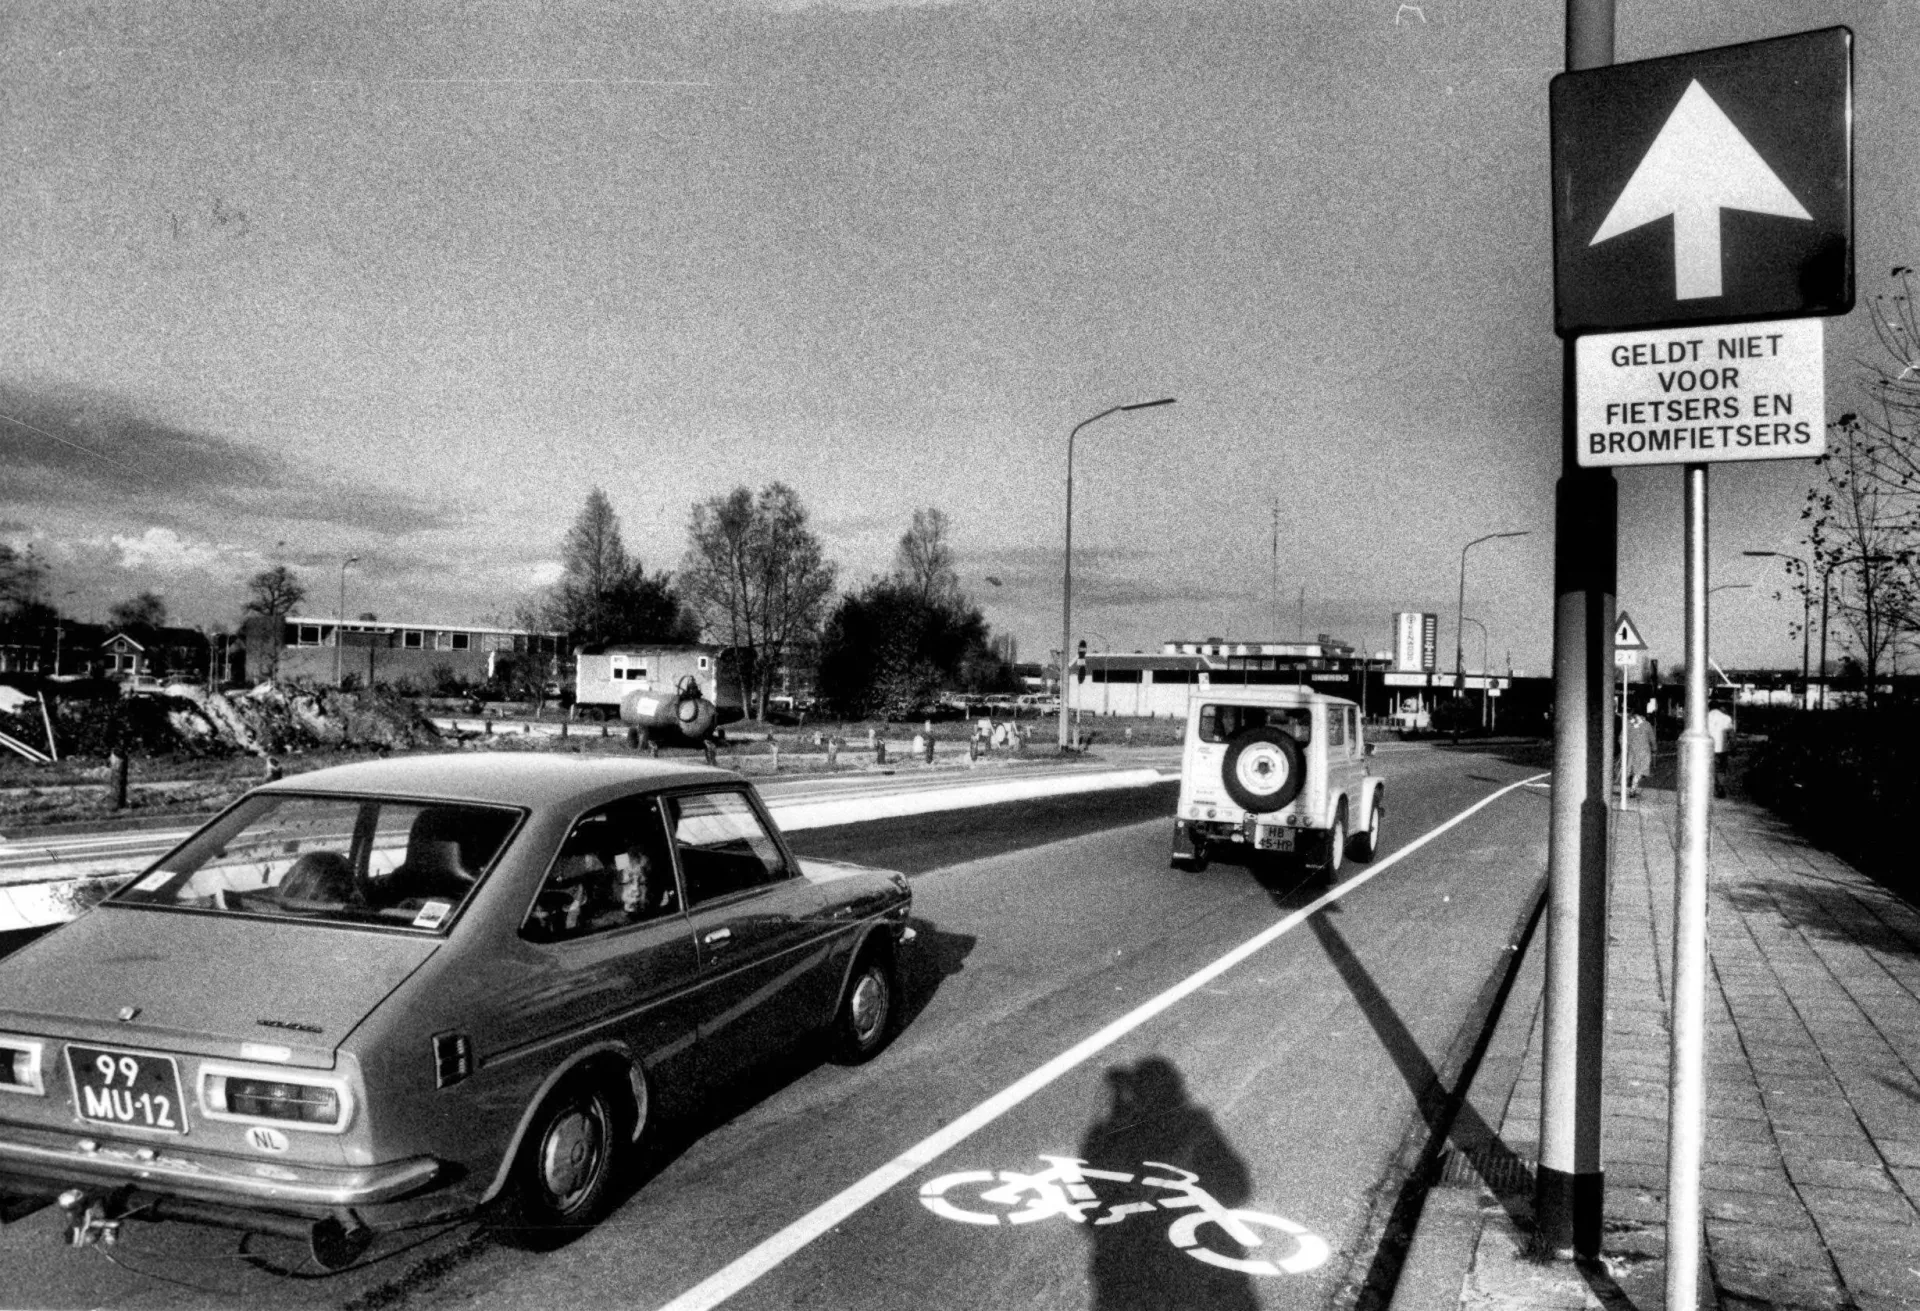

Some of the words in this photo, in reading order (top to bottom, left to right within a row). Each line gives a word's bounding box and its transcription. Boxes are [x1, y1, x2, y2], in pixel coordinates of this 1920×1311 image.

[1612, 340, 1703, 367] GELDT
[1718, 335, 1783, 360] NIET
[1658, 368, 1739, 392] VOOR
[1607, 397, 1739, 425] FIETSERS
[1753, 395, 1793, 417] EN
[1590, 422, 1811, 454] BROMFIETSERS
[96, 1055, 140, 1086] 99
[253, 1130, 281, 1150] NL
